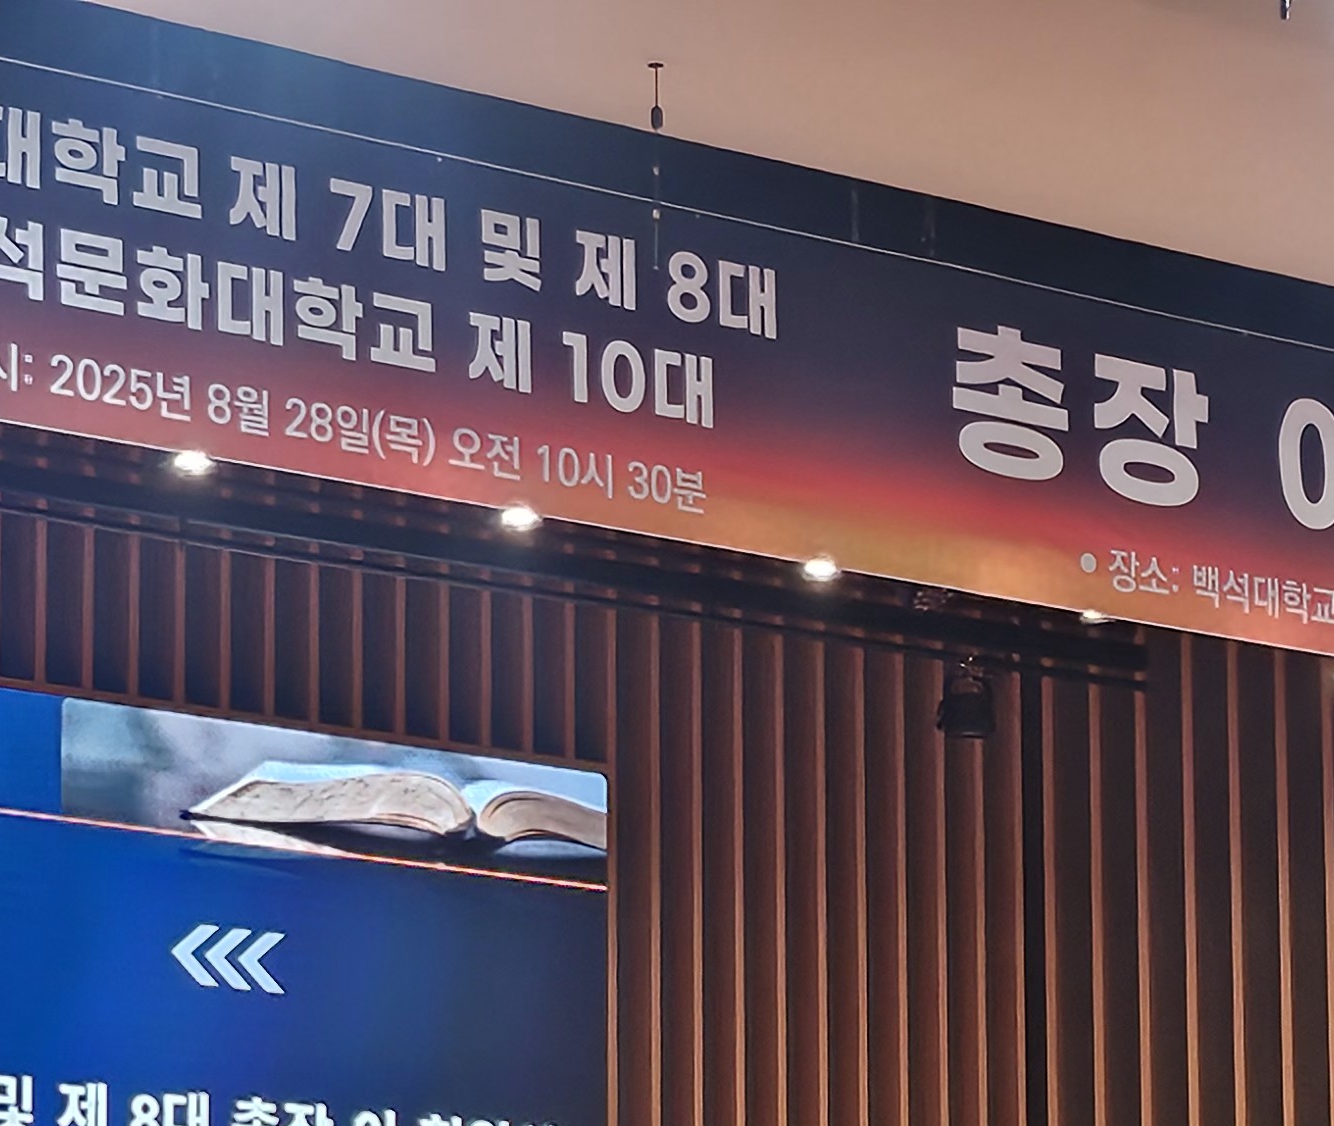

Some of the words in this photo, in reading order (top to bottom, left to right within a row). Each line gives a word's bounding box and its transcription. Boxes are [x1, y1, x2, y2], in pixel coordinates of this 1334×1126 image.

[230, 156, 296, 240] 제
[330, 178, 445, 271] 7대
[481, 209, 541, 288] 및
[575, 230, 635, 310] 제
[667, 251, 776, 339] 8대
[50, 355, 190, 421] 2025년
[208, 384, 269, 436] 8월
[285, 398, 435, 466] 28일(목)
[448, 429, 520, 480] 오전
[538, 445, 612, 498] 10시
[628, 462, 706, 514] 30분
[469, 312, 531, 393] 제
[563, 331, 713, 428] 10대
[953, 326, 1208, 506] 총장
[1109, 550, 1178, 594] 장소:
